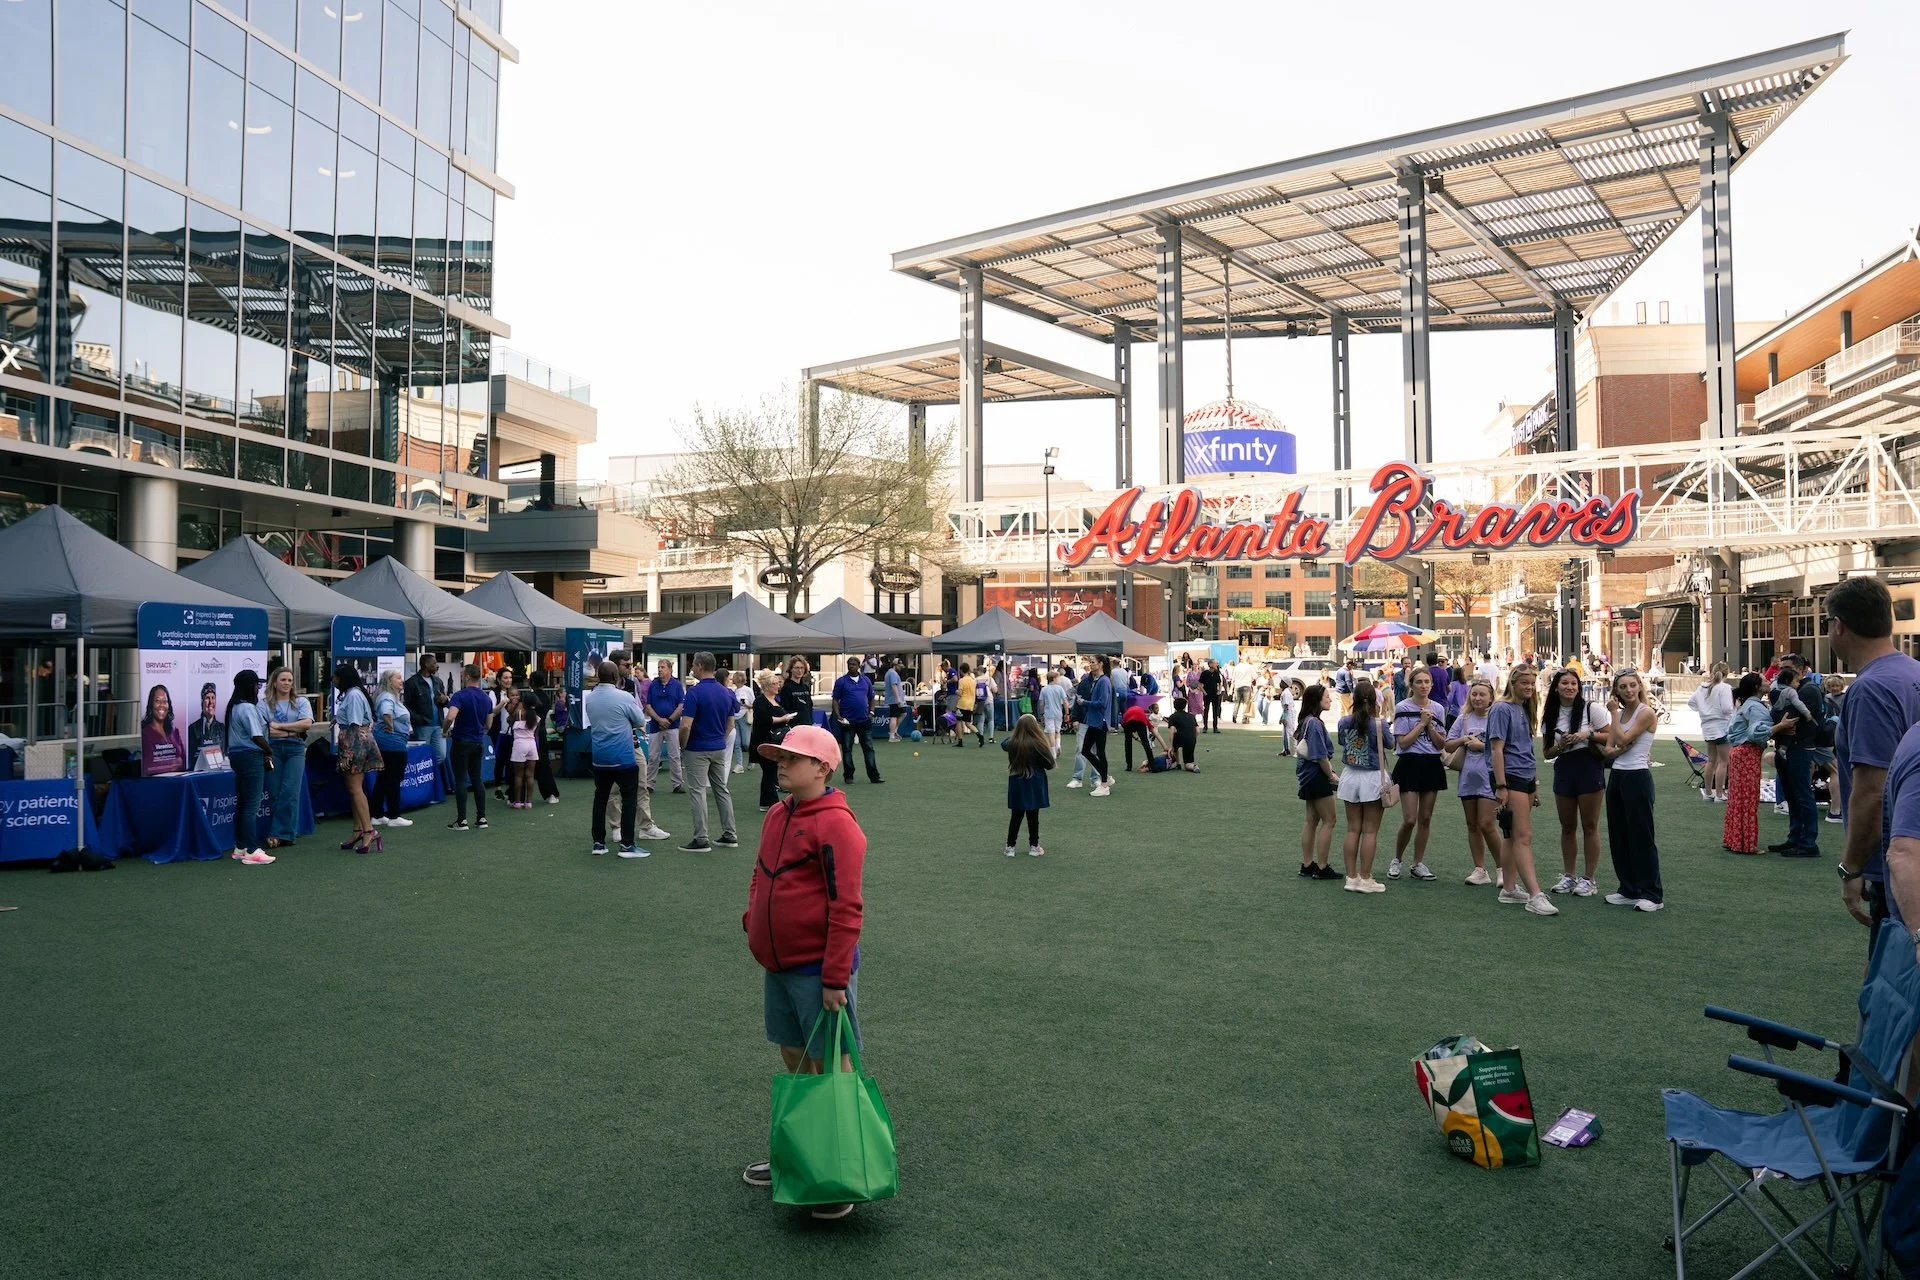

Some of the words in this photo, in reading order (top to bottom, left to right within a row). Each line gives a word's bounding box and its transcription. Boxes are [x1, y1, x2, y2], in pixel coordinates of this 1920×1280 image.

[1194, 436, 1277, 466] xfinity
[1057, 484, 1334, 568] Atlanta
[1344, 460, 1643, 567] Braves
[1035, 603, 1061, 618] UP
[161, 631, 183, 639] portfolio
[225, 633, 249, 641] recognizes
[162, 639, 180, 647] unique
[180, 639, 199, 647] journey
[6, 813, 70, 827] science.
